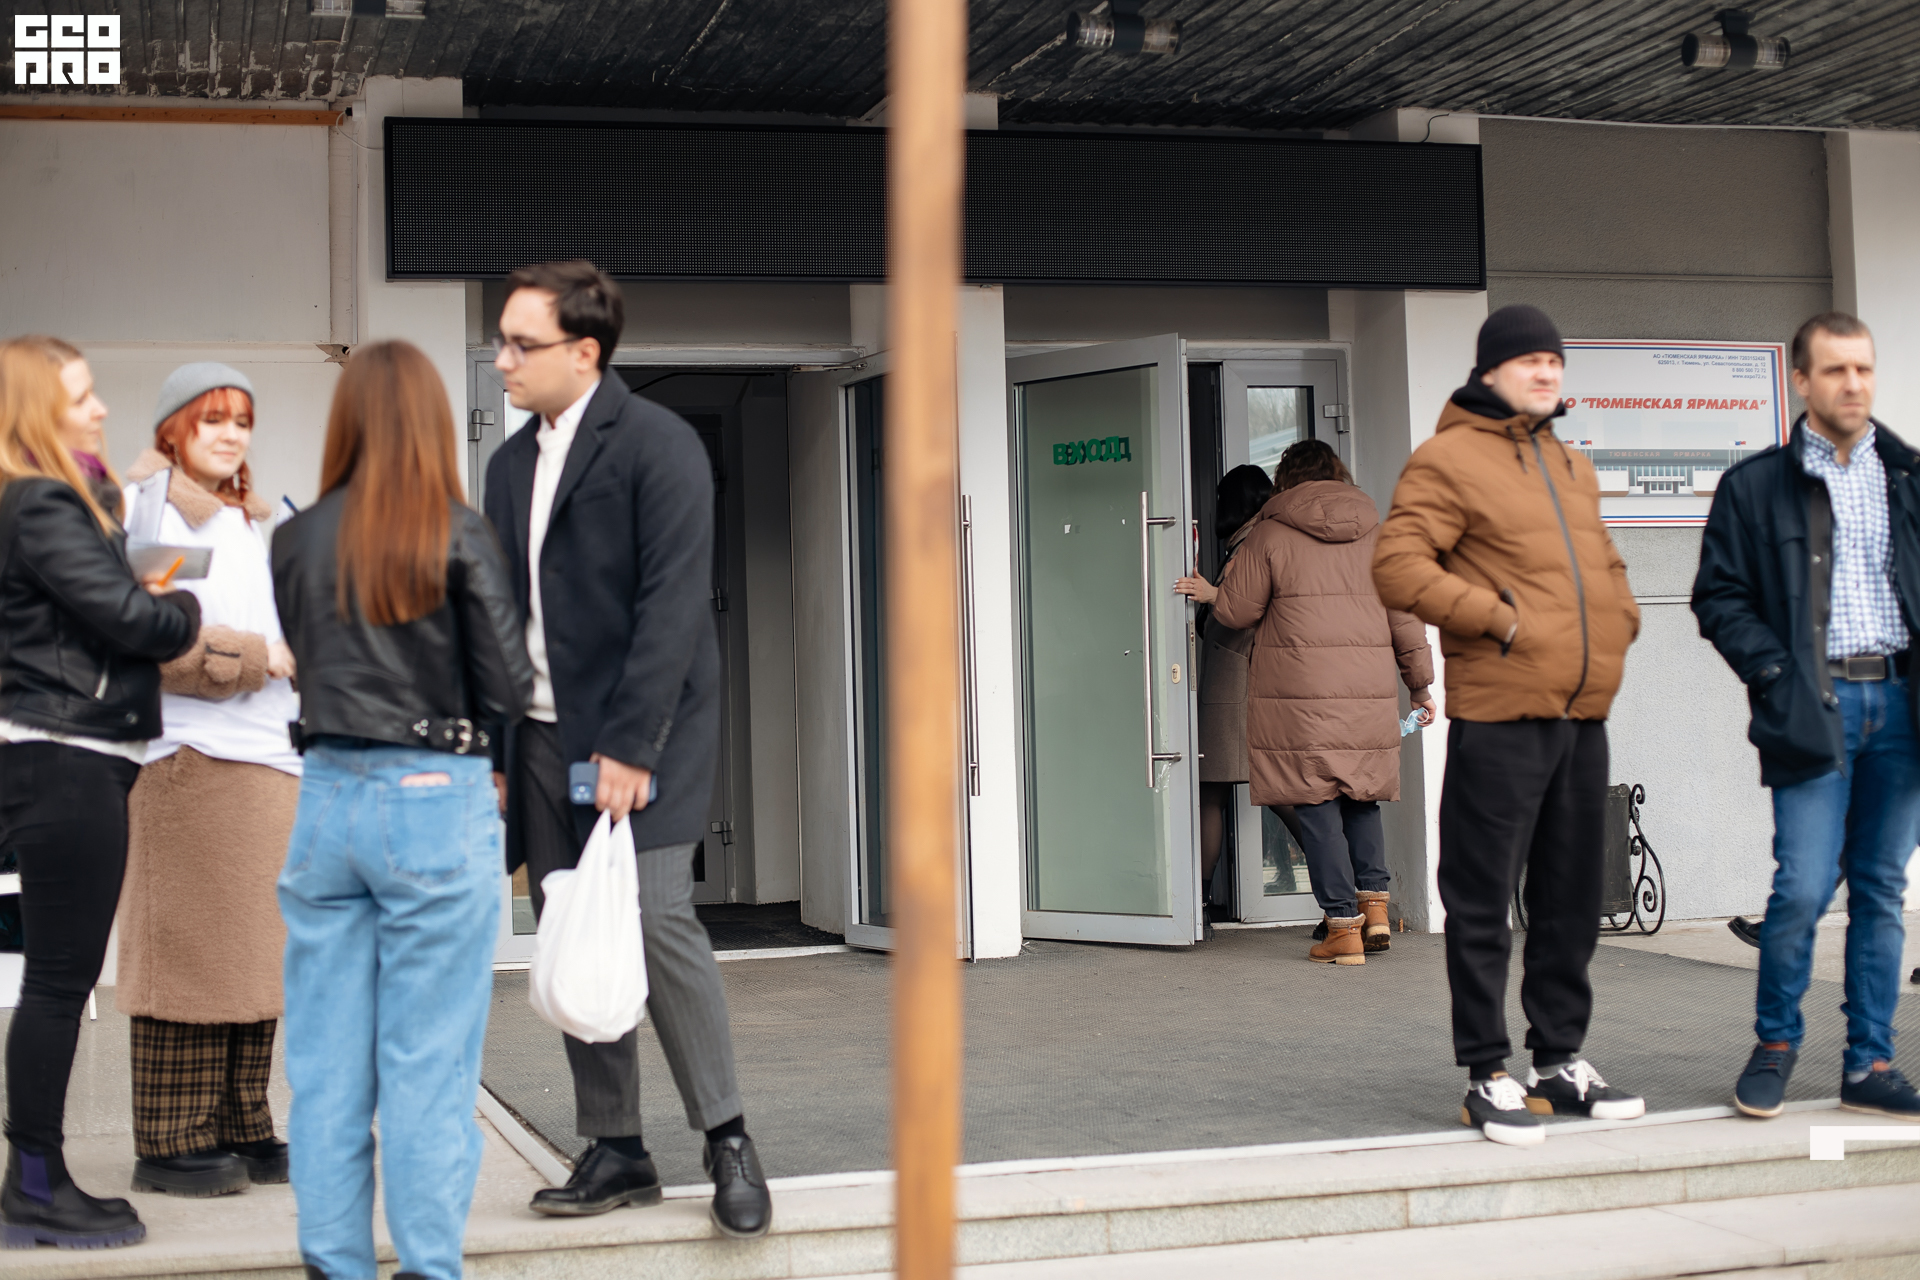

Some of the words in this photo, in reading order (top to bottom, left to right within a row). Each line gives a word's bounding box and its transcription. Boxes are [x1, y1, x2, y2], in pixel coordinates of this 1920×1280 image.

[1581, 397, 1683, 409] "ТЮМЕНСКАЯ
[1686, 398, 1767, 410] ЯРМАРКА"
[1053, 436, 1122, 465] ВХОД
